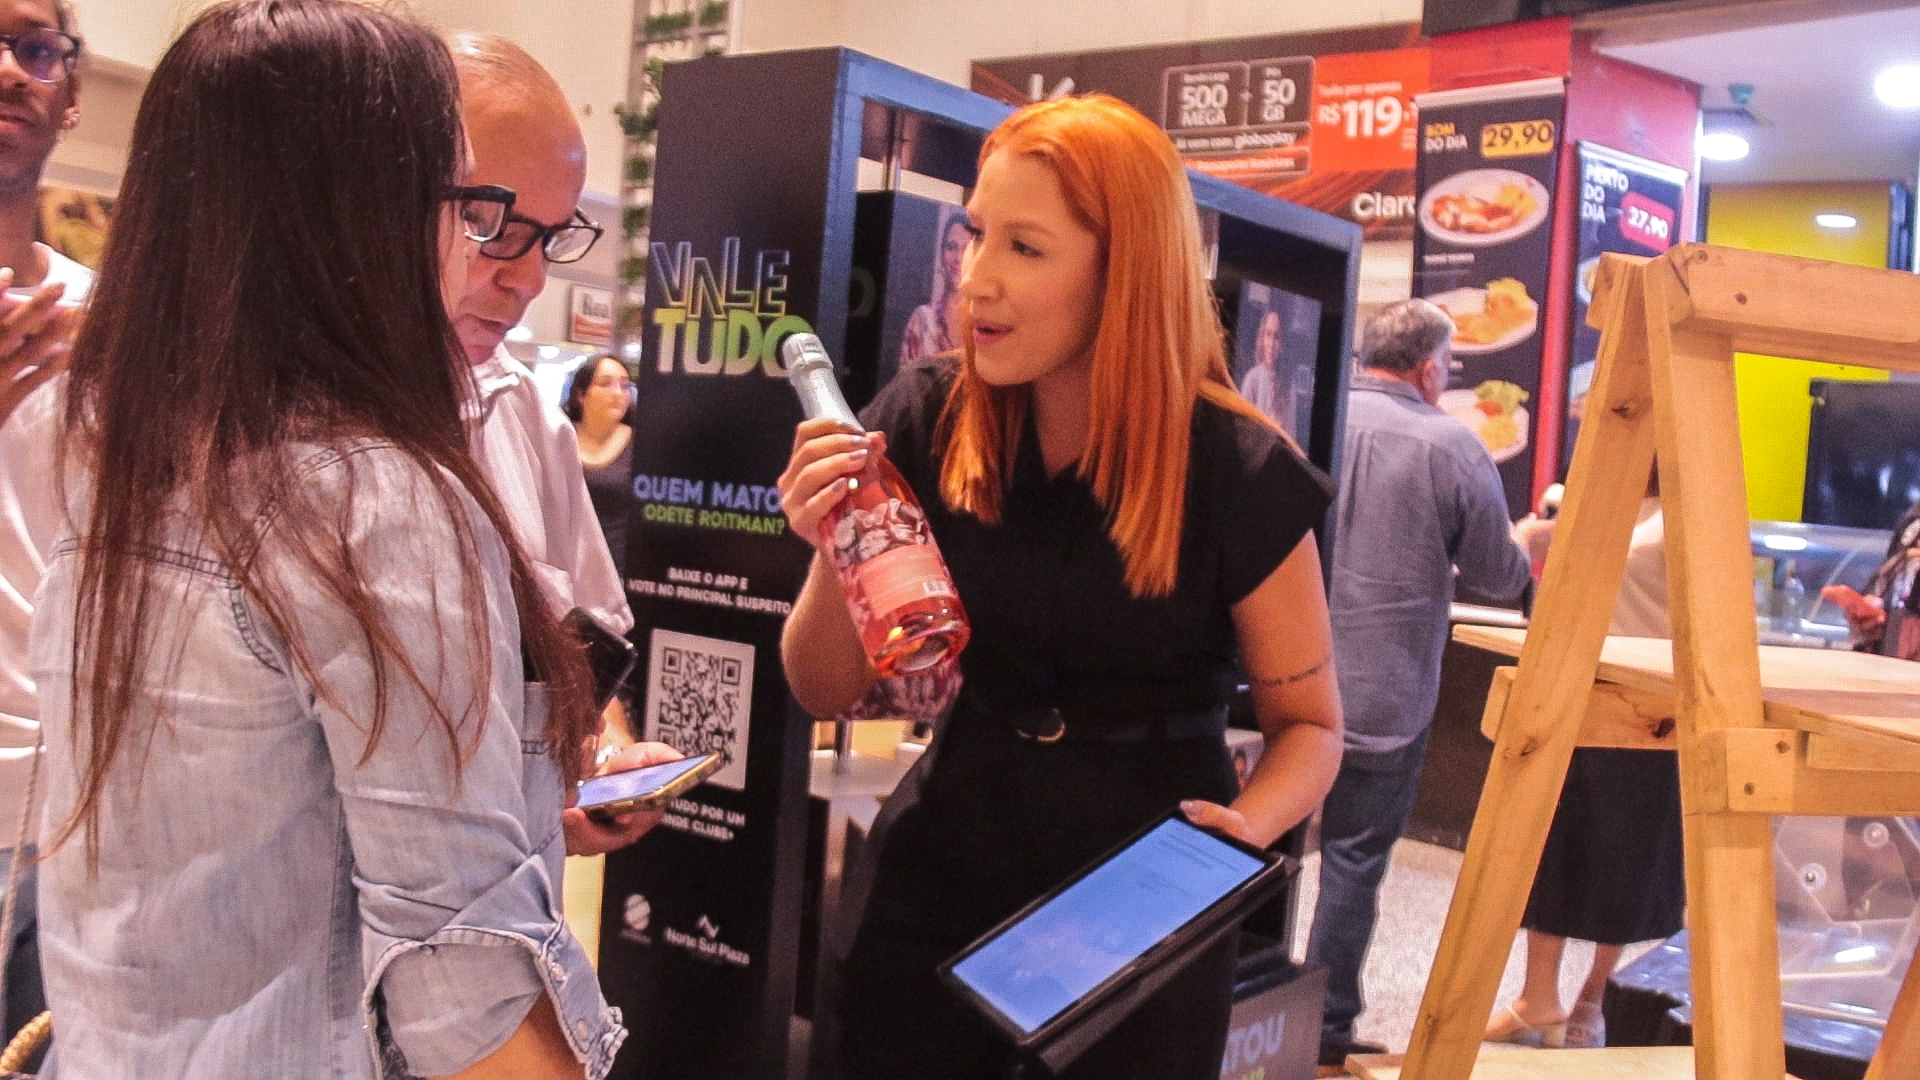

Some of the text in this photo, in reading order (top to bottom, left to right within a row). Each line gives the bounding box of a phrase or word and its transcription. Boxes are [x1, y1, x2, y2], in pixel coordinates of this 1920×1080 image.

[1182, 84, 1228, 110] 500
[1264, 79, 1296, 104] 50
[1182, 109, 1227, 126] MEGA
[1264, 104, 1285, 121] GB
[1424, 137, 1445, 153] DO
[1446, 134, 1468, 150] DIA
[1484, 122, 1553, 151] 29,90
[1584, 182, 1605, 204] DO
[1583, 200, 1606, 224] DIA
[650, 236, 790, 319] VALE
[653, 308, 815, 378] TUDO
[633, 474, 781, 513] QUEM MATO
[643, 504, 785, 535] ODETE ROITMAN?
[667, 567, 748, 591] BAIXE O APP E
[628, 578, 792, 614] VOTE NO PRINCIPAL SUSPEITO
[700, 804, 724, 821] POR
[726, 810, 745, 828] UM
[698, 936, 717, 954] Sul
